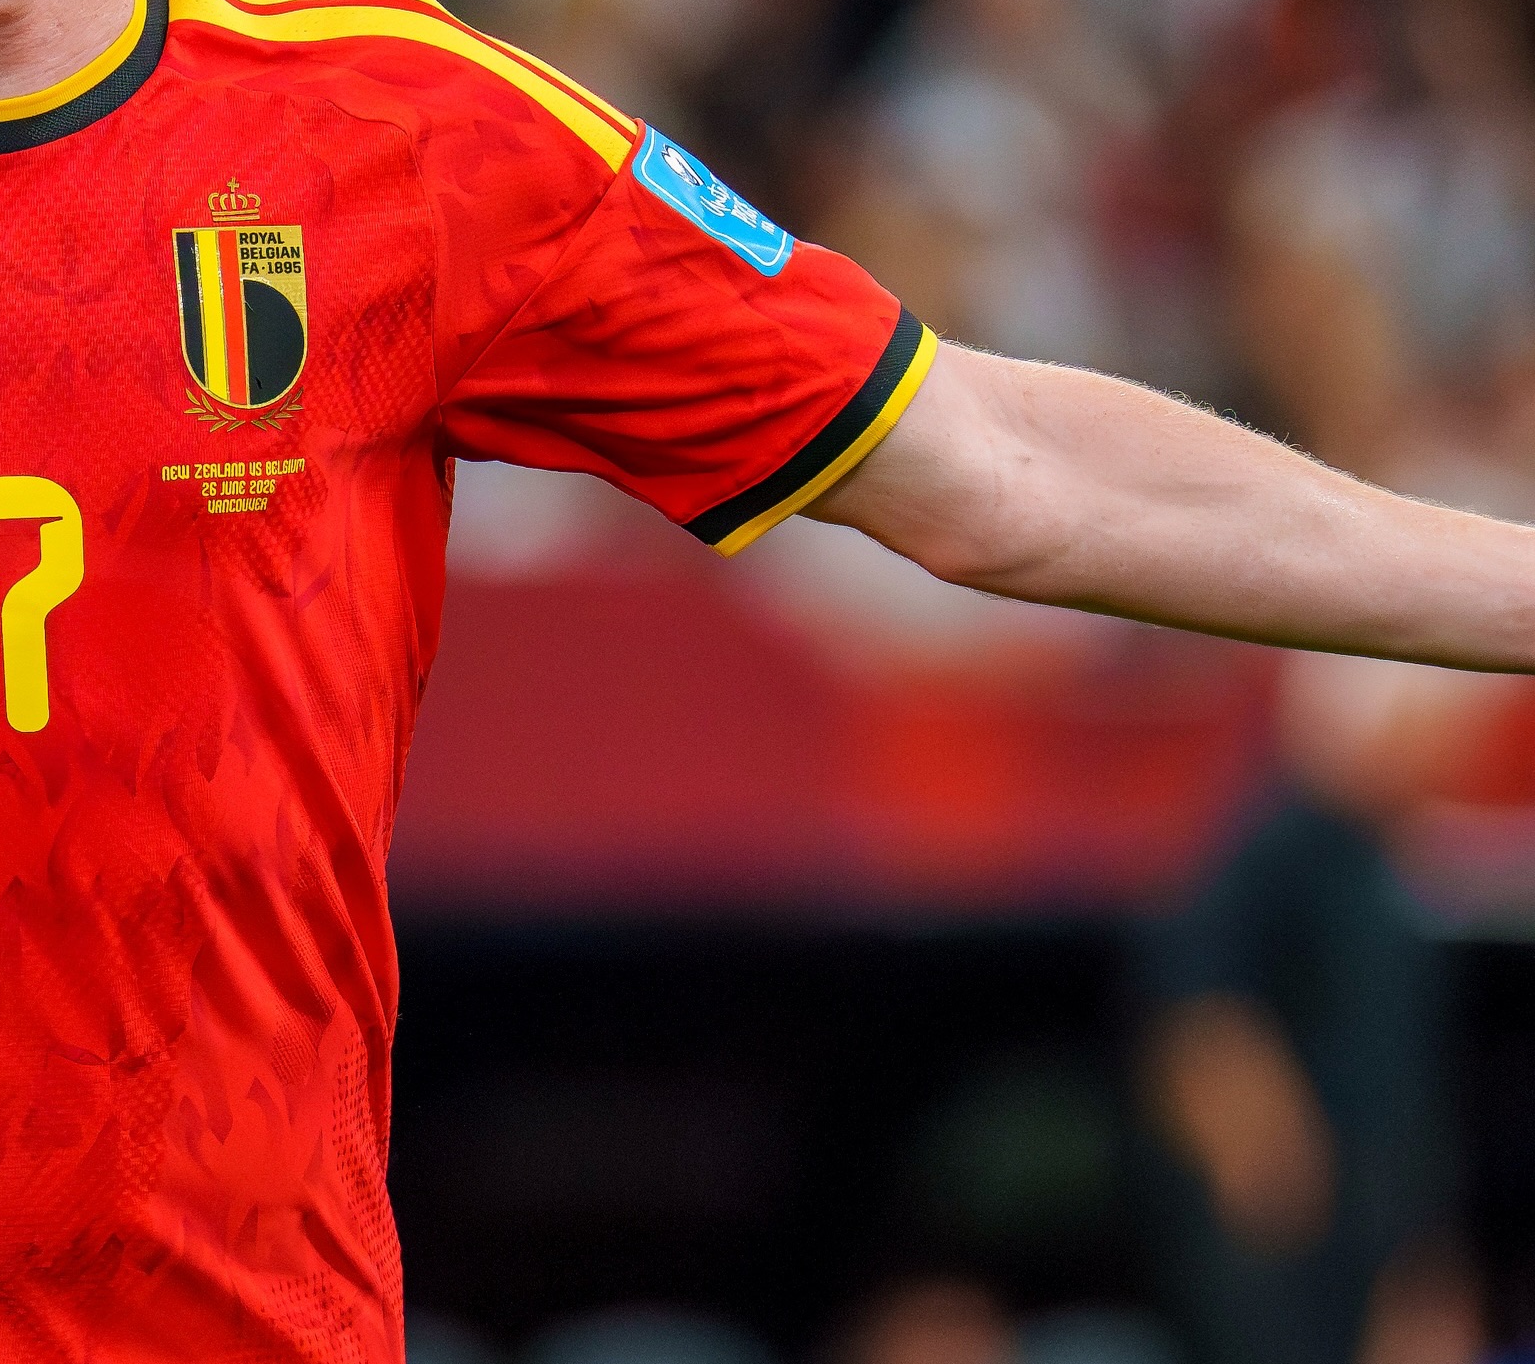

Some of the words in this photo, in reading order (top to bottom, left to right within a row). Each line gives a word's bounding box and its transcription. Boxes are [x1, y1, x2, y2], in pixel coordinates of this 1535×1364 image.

[239, 232, 285, 245] ROYAL
[240, 246, 301, 260] BELGIAN
[162, 464, 190, 482] NEW
[194, 462, 246, 479] ZEALAND
[265, 458, 306, 476] BELGIUM
[201, 481, 217, 497] 26
[220, 480, 246, 496] JUNE
[249, 479, 276, 494] 2026
[207, 497, 268, 514] VANCOUVER
